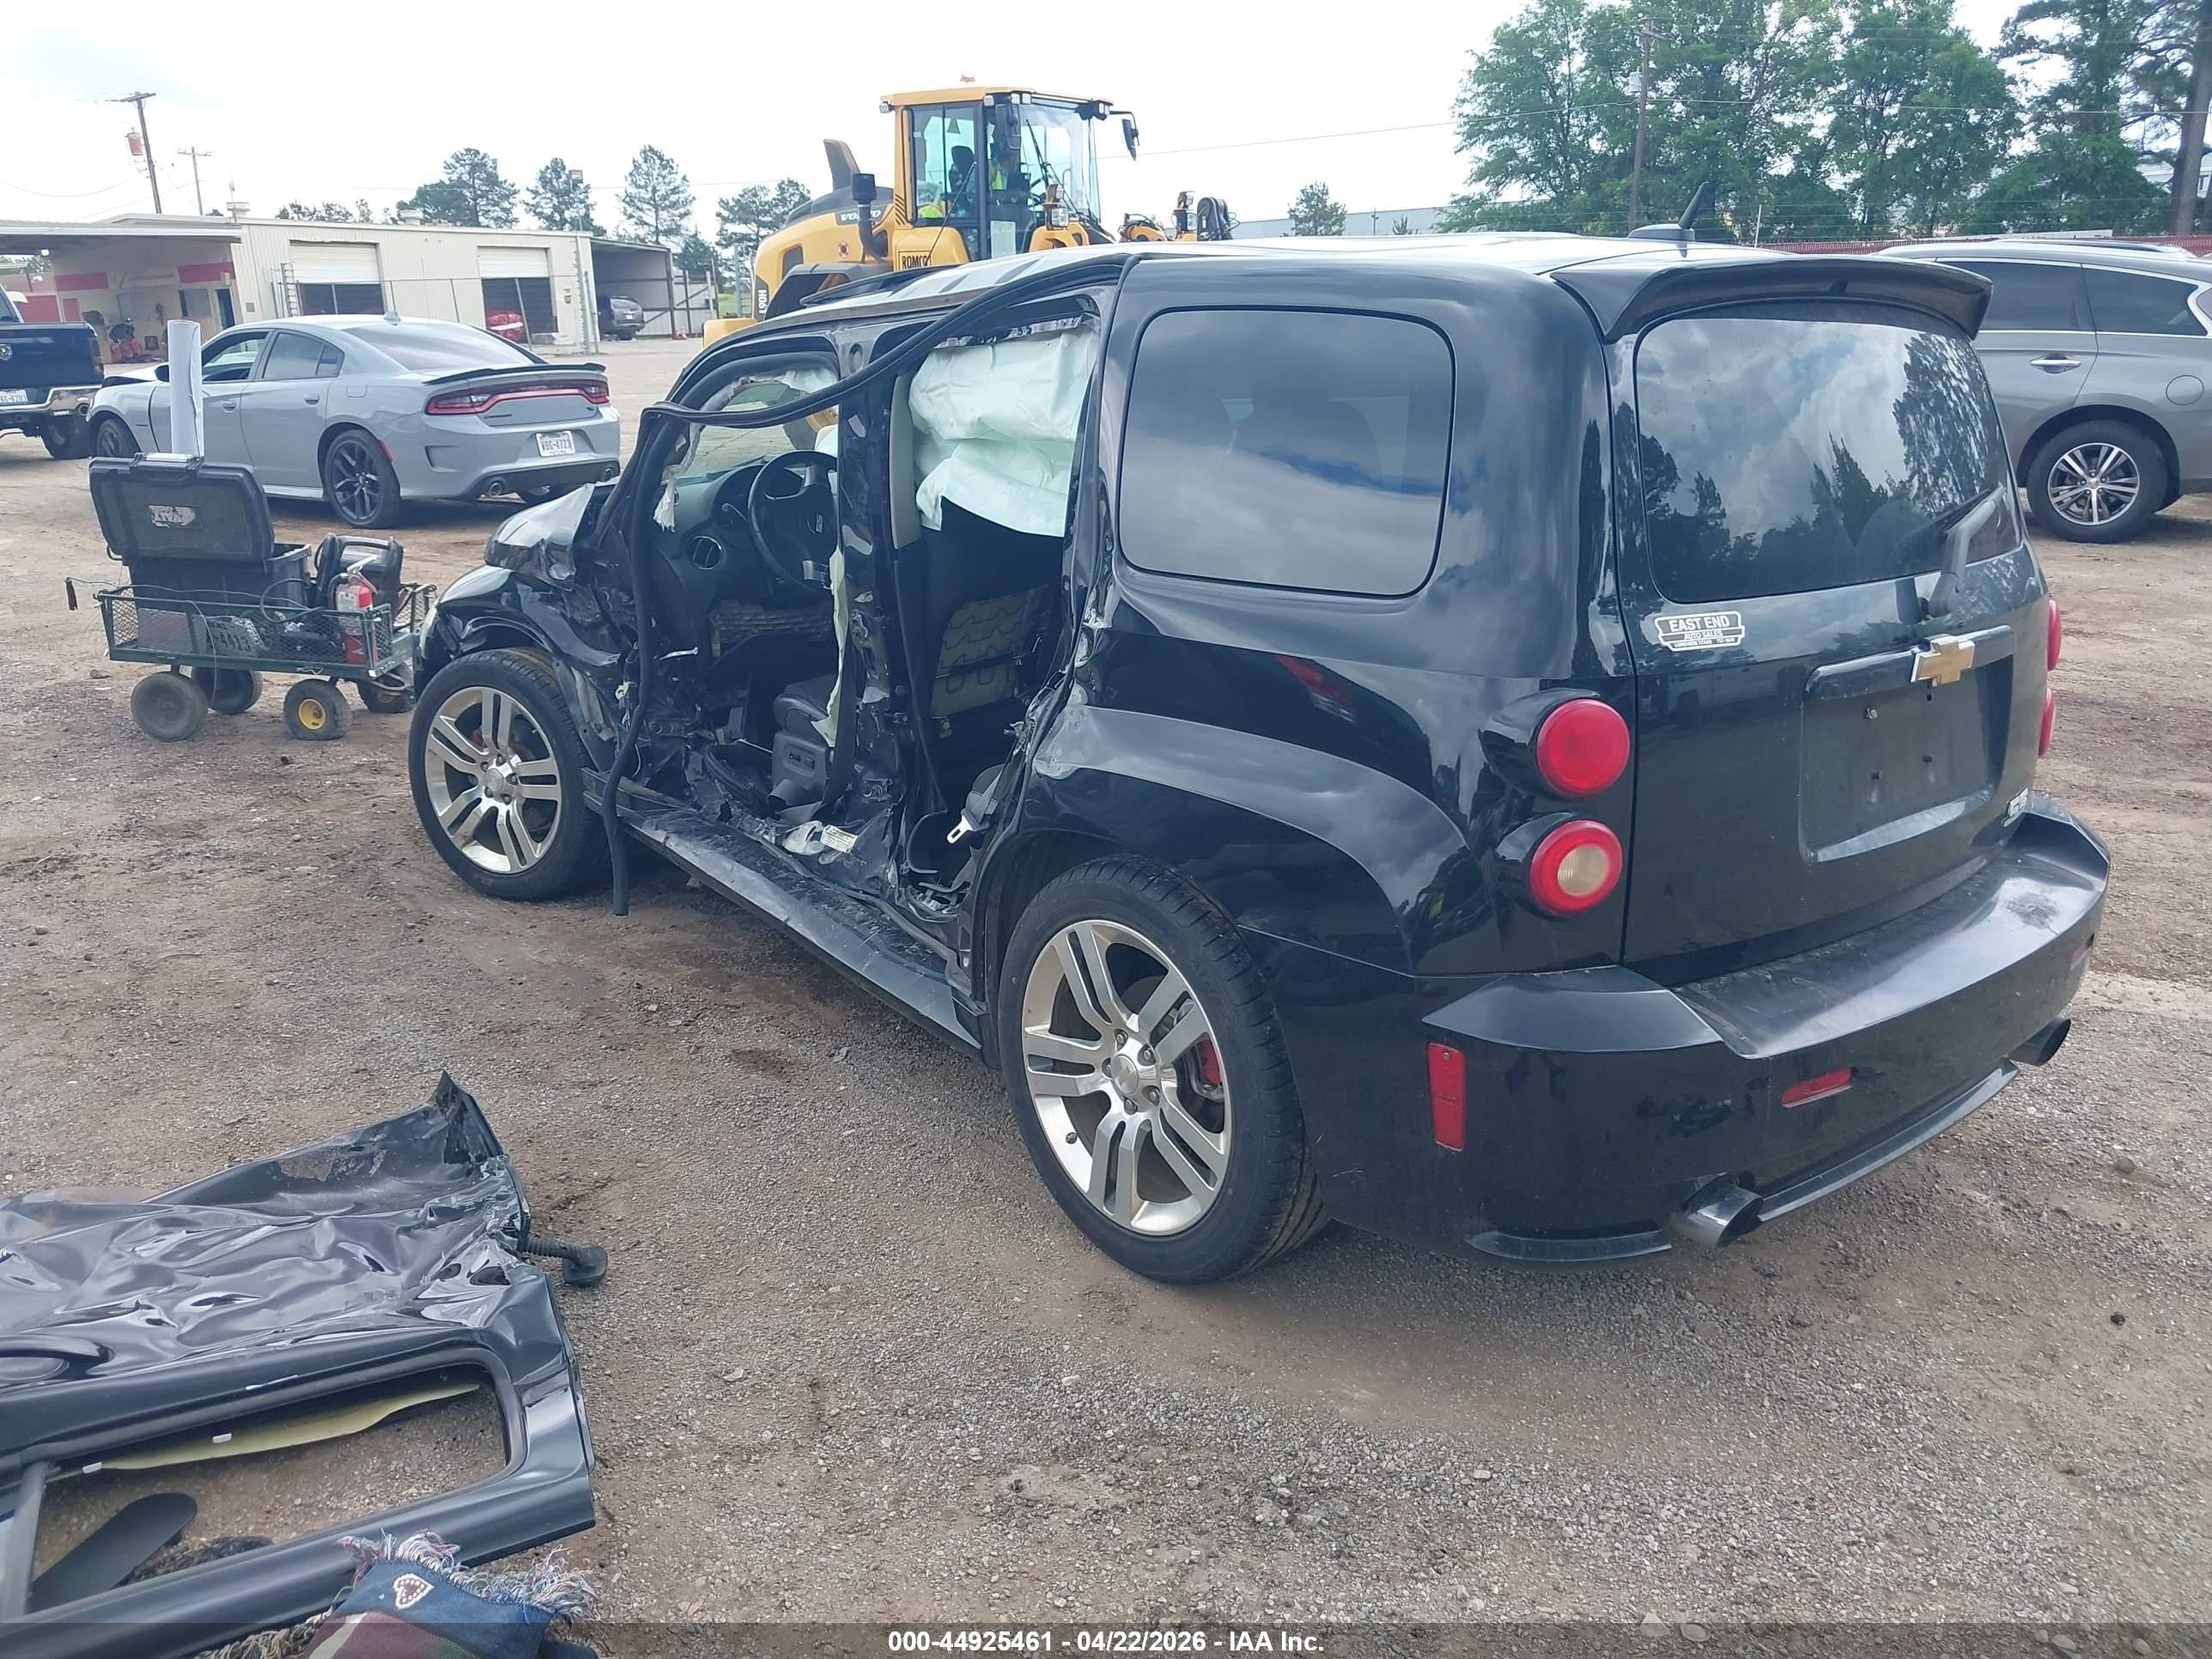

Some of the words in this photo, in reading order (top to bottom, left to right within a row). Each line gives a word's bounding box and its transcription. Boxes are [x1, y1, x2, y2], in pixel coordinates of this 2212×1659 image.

[841, 210, 881, 222] VOO
[1668, 617, 1701, 632] EAST
[1704, 615, 1730, 629] END
[1684, 632, 1701, 641] AUTO
[1702, 629, 1723, 639] SALES
